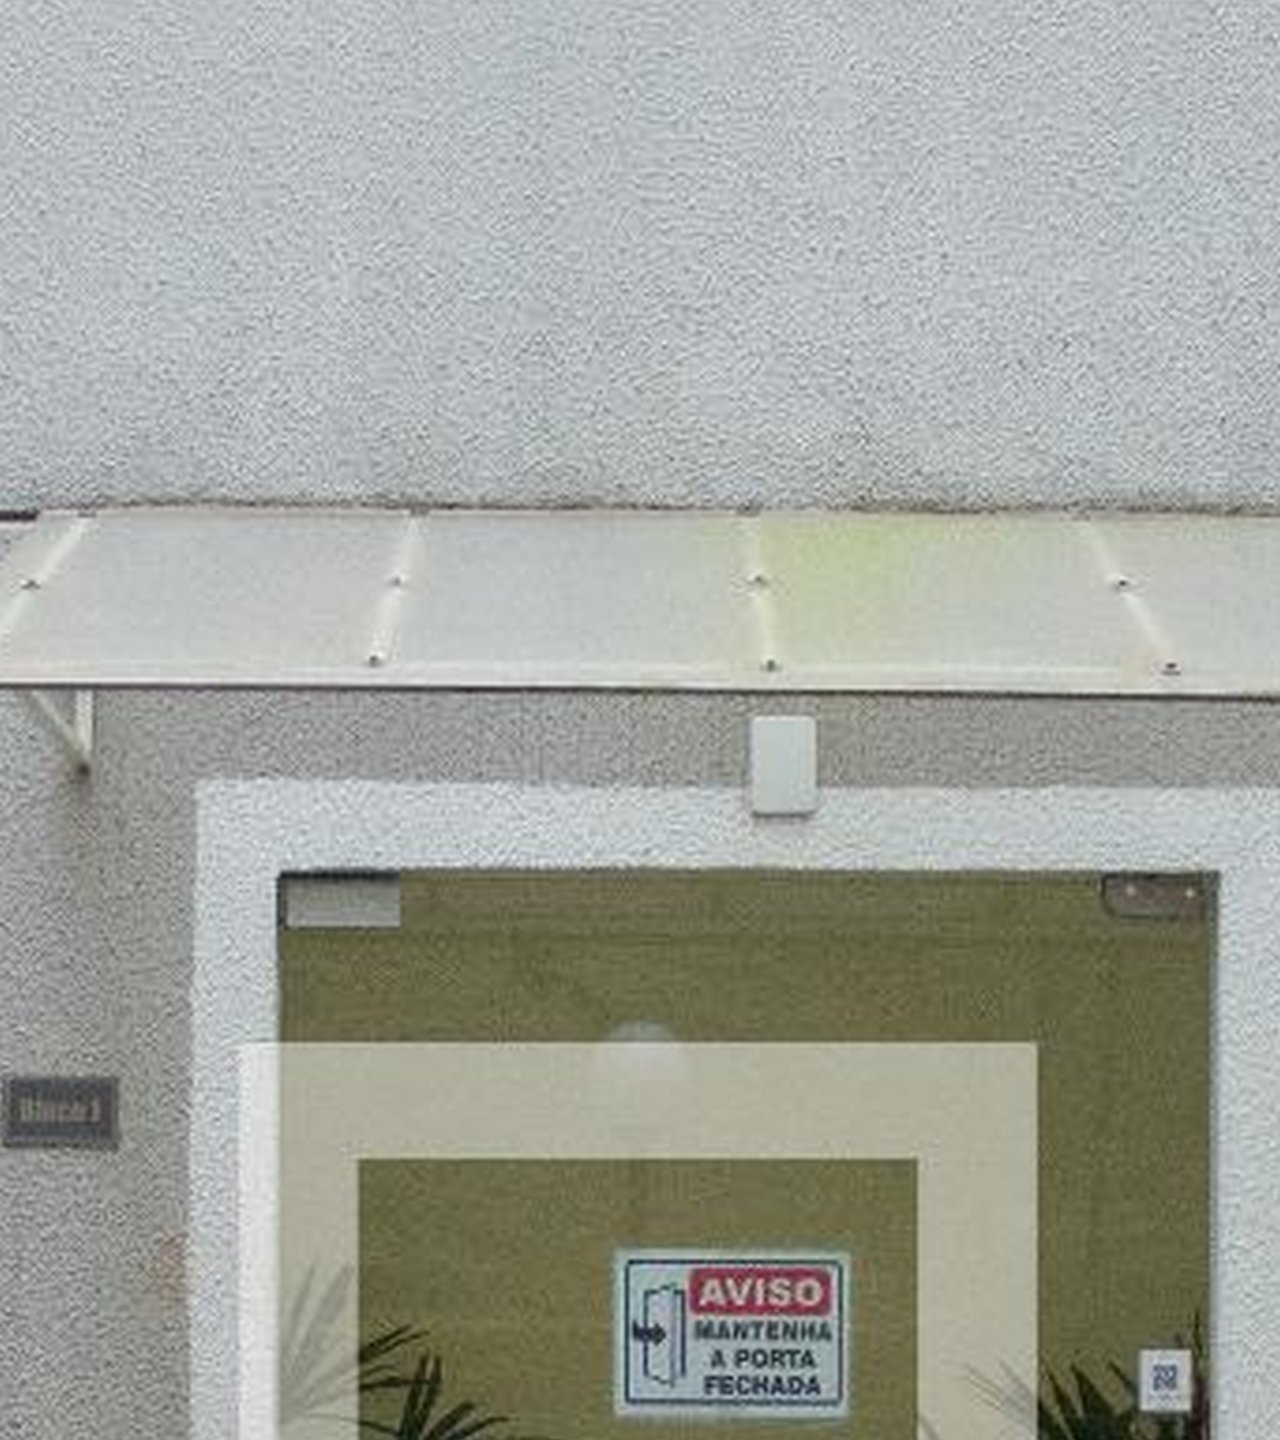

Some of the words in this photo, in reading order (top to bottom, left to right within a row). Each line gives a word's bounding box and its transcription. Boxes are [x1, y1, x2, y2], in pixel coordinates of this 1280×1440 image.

[698, 1277, 822, 1307] AVISO
[694, 1320, 832, 1341] MANTENHA
[710, 1349, 726, 1369] A
[734, 1349, 816, 1369] PORTA
[703, 1376, 821, 1396] FECHADA
